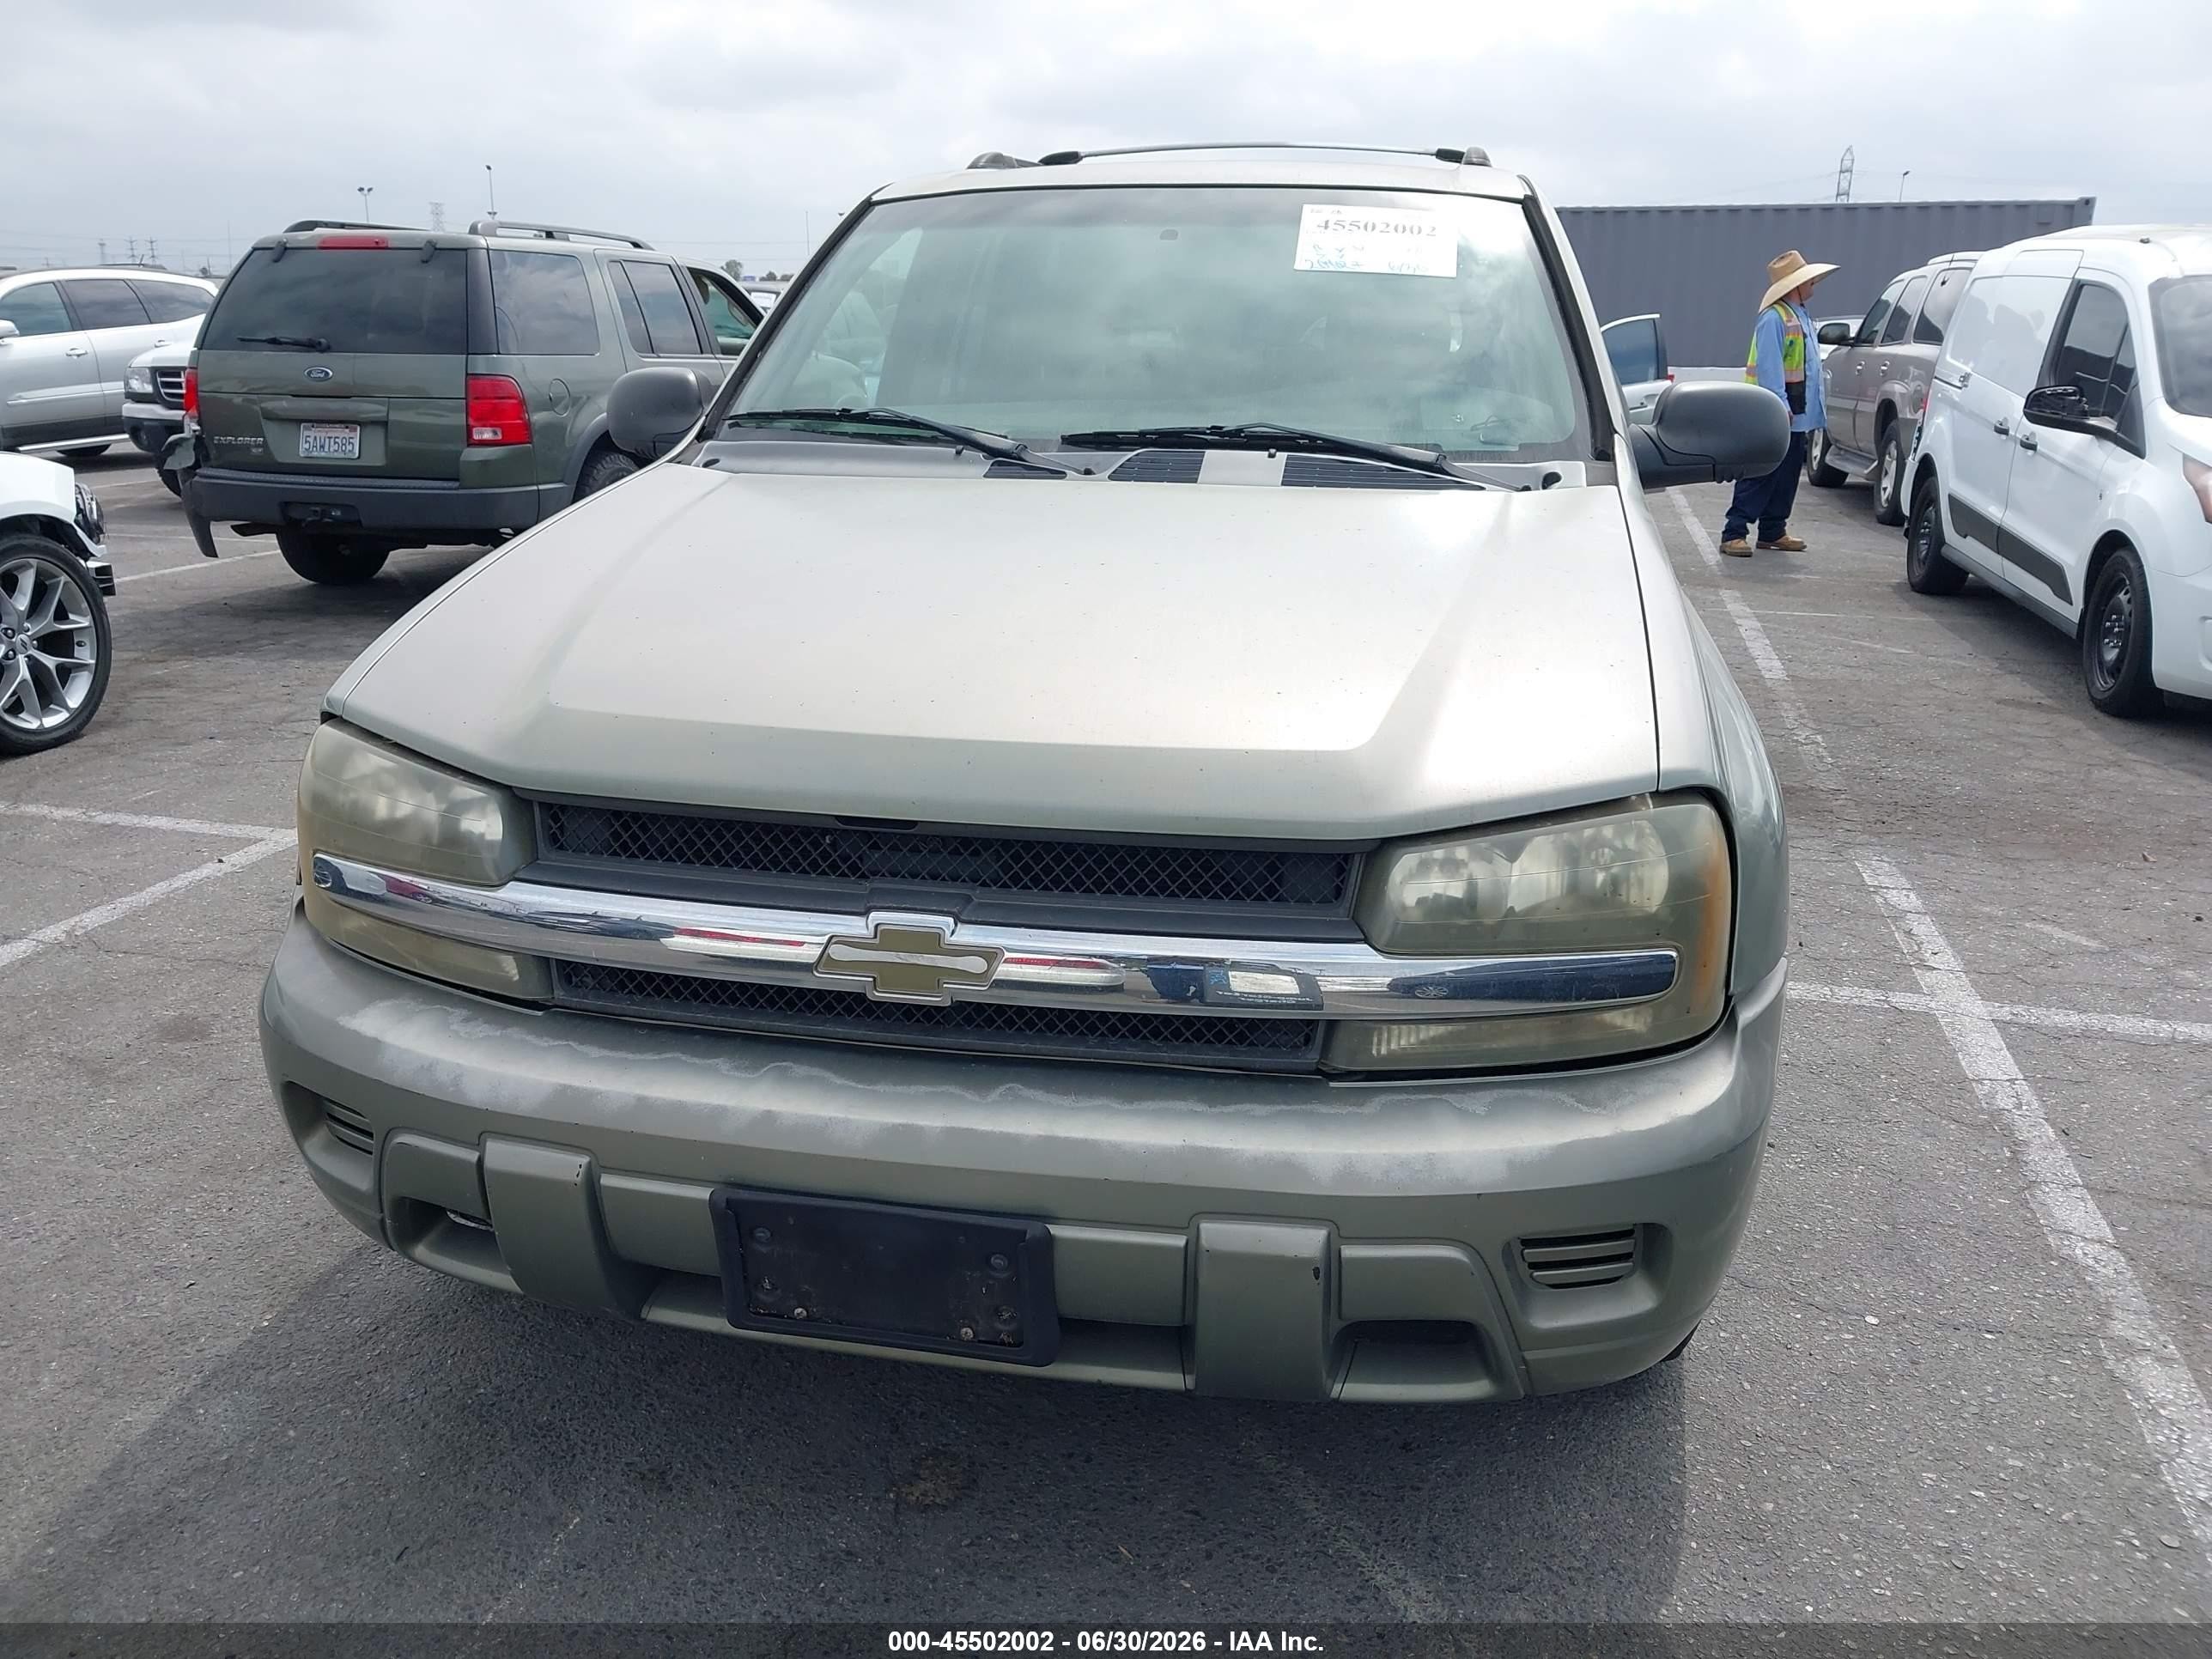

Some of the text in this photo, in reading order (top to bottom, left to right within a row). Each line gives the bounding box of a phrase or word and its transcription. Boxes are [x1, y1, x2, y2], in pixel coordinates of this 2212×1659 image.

[1316, 219, 1437, 237] 45502002
[213, 435, 264, 445] EXPLORER
[304, 434, 355, 454] 5AWT585
